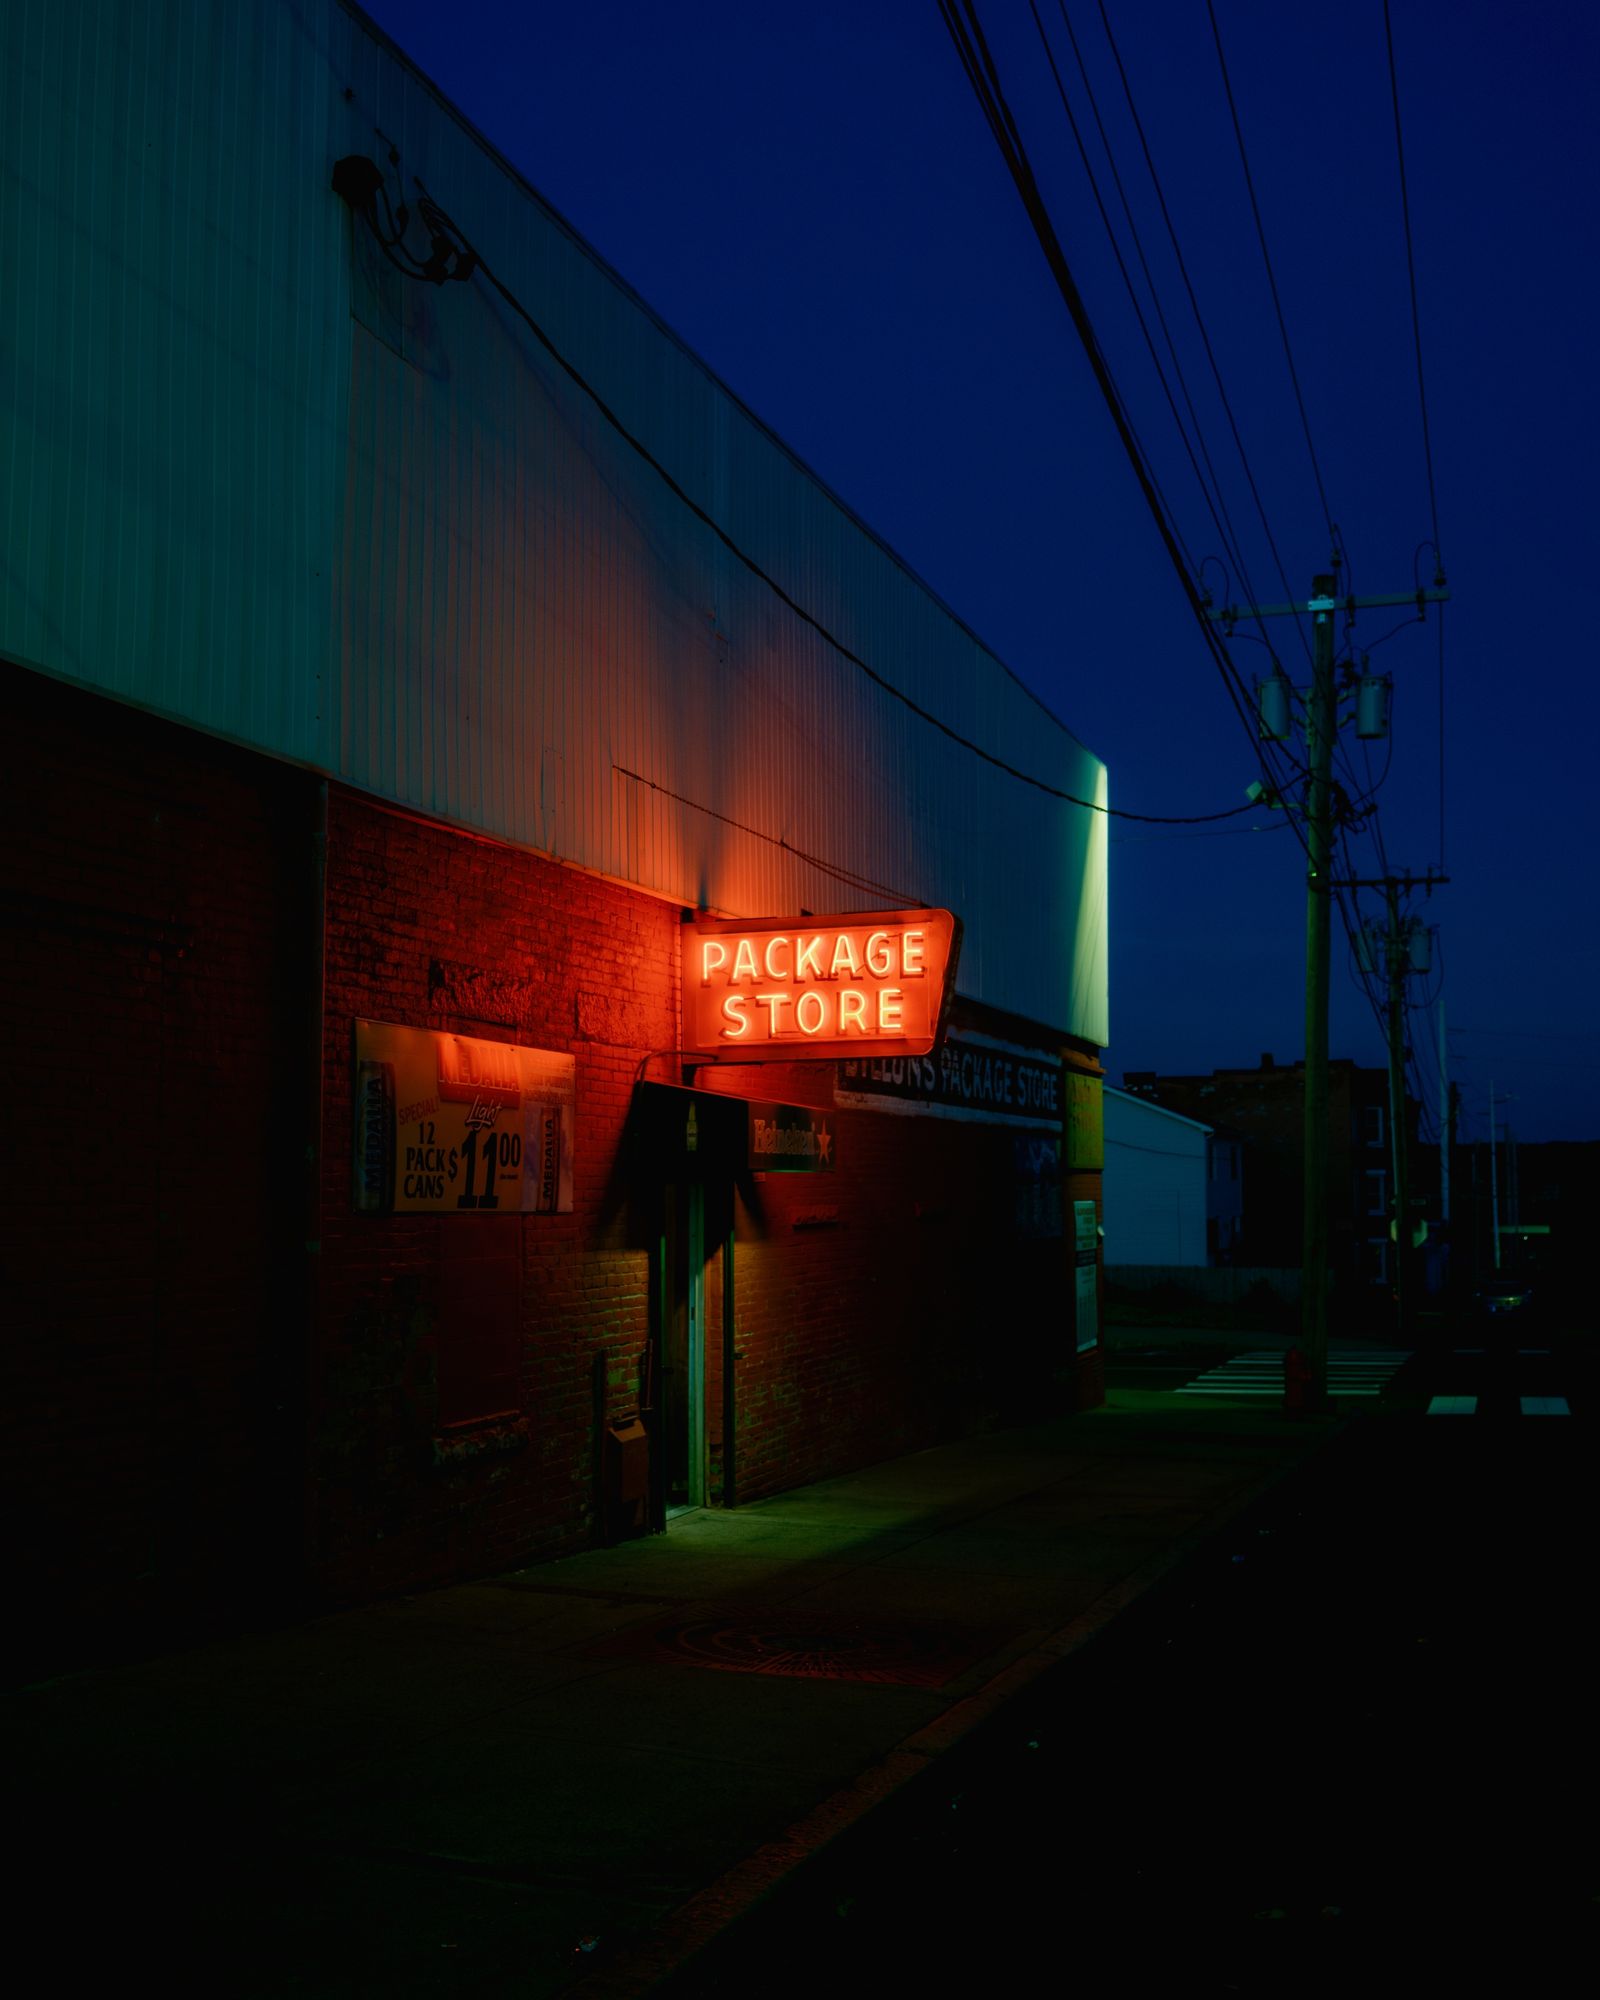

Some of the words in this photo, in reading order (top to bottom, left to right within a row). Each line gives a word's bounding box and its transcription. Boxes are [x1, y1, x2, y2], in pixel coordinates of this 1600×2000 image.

[702, 931, 925, 981] PACKAGE
[723, 988, 903, 1037] STORE
[940, 1047, 1013, 1104] PACKAGE
[1016, 1064, 1059, 1111] STORE
[418, 1121, 436, 1145] 12
[465, 1094, 503, 1131] Light
[406, 1146, 446, 1172] PACK
[543, 1119, 554, 1200] MEDALLA
[403, 1174, 444, 1199] CANS
